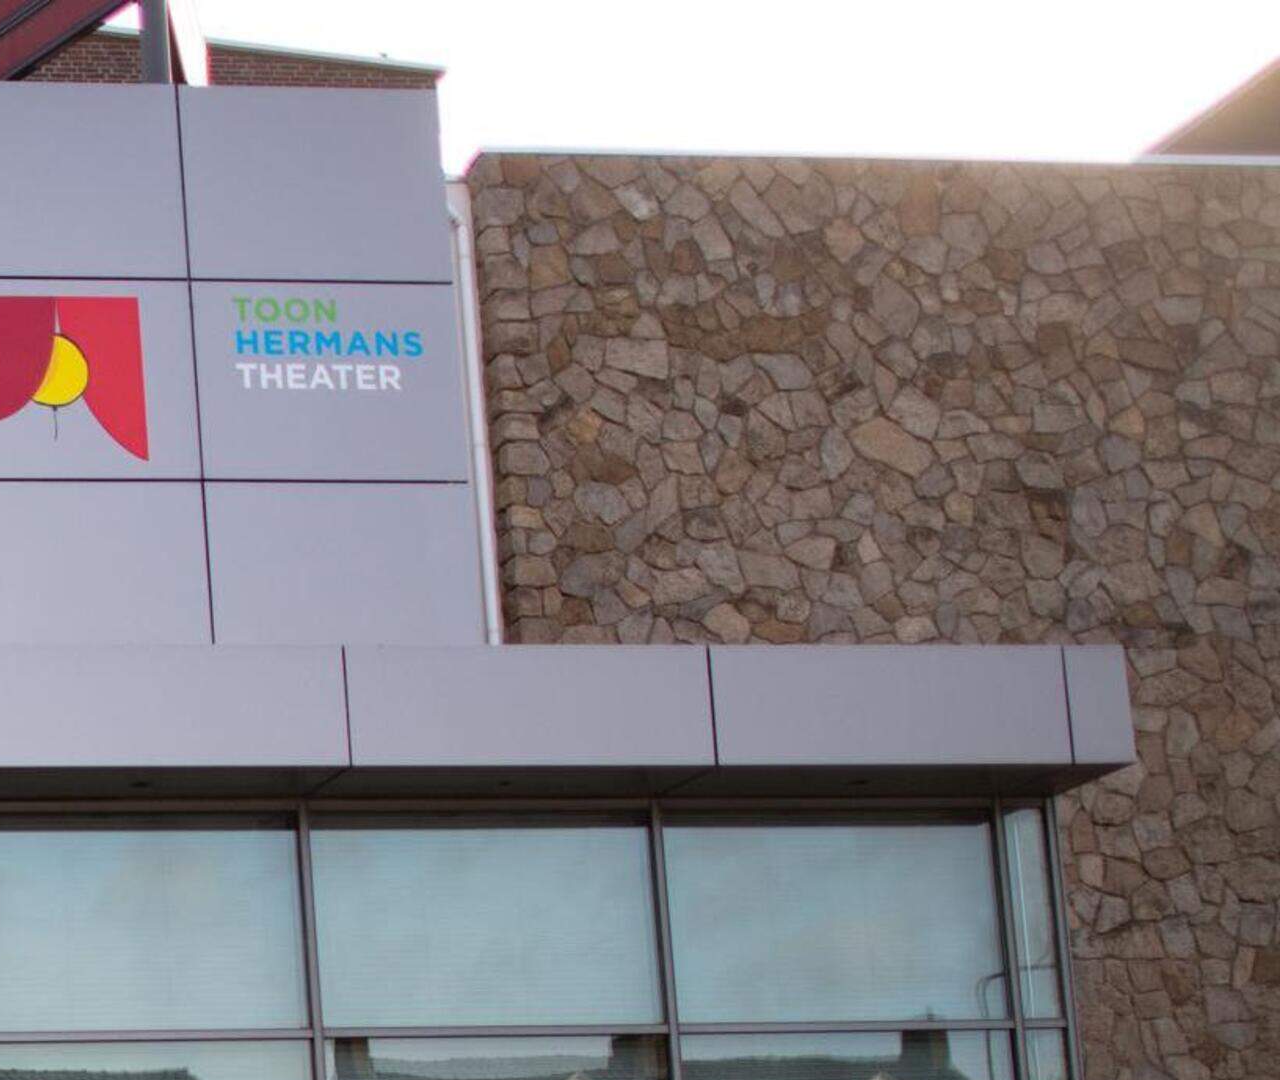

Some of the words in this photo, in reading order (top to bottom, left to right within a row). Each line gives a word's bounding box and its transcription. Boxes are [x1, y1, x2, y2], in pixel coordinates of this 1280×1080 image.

[233, 297, 337, 323] TOON
[235, 329, 424, 358] HERMANS
[235, 362, 402, 390] THEATER
